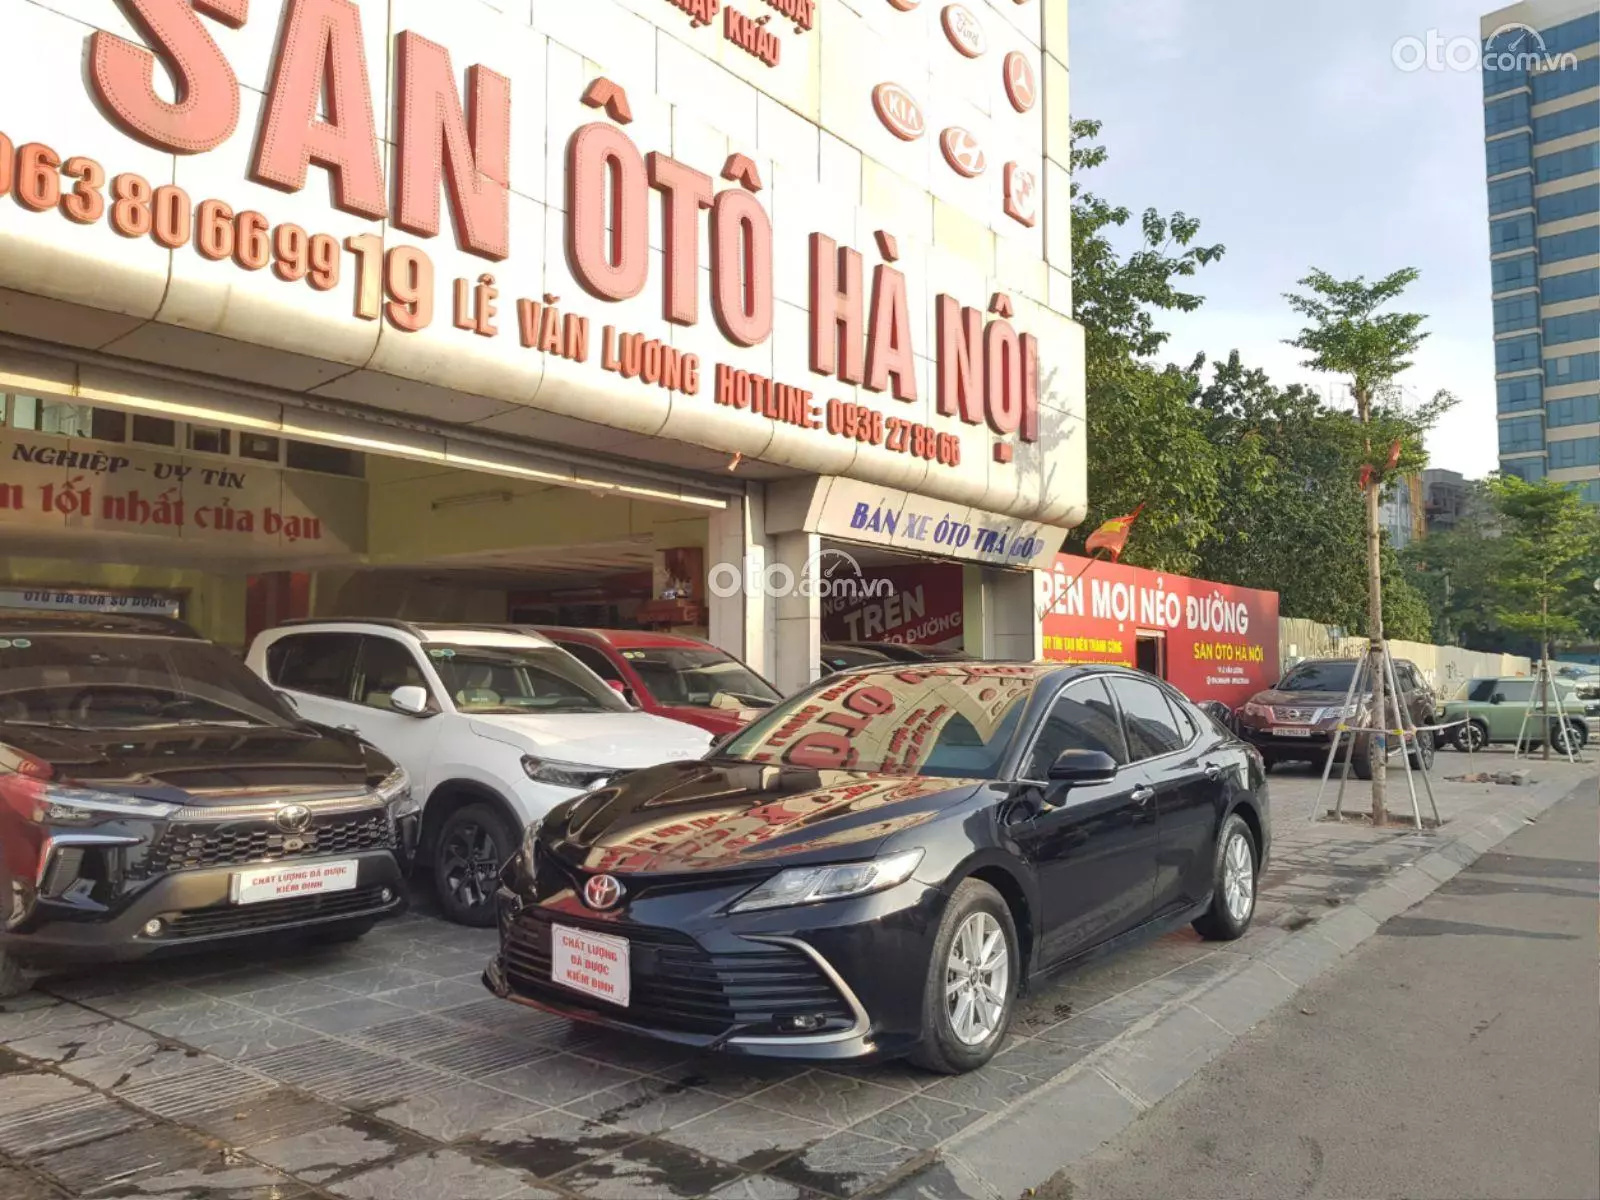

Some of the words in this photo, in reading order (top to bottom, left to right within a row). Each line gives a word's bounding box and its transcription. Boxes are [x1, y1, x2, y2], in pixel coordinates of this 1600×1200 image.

[567, 76, 772, 347] ÔTÔ
[808, 229, 917, 403] HÀ
[935, 291, 1038, 464] NỘI
[453, 273, 498, 338] LÊ
[516, 292, 589, 364] VĂN
[714, 362, 823, 430] HOTLINE:
[12, 442, 130, 476] NGHIỆP
[200, 466, 247, 490] TÍN
[38, 474, 93, 517] tốt
[103, 486, 184, 528] nhất
[194, 495, 254, 534] của
[263, 507, 322, 542] bạn
[850, 497, 901, 536] BÁN
[901, 512, 933, 541] XE
[1091, 577, 1136, 632] MỌI
[1141, 577, 1182, 629] NẺO
[1186, 589, 1249, 636] ĐƯỜNG
